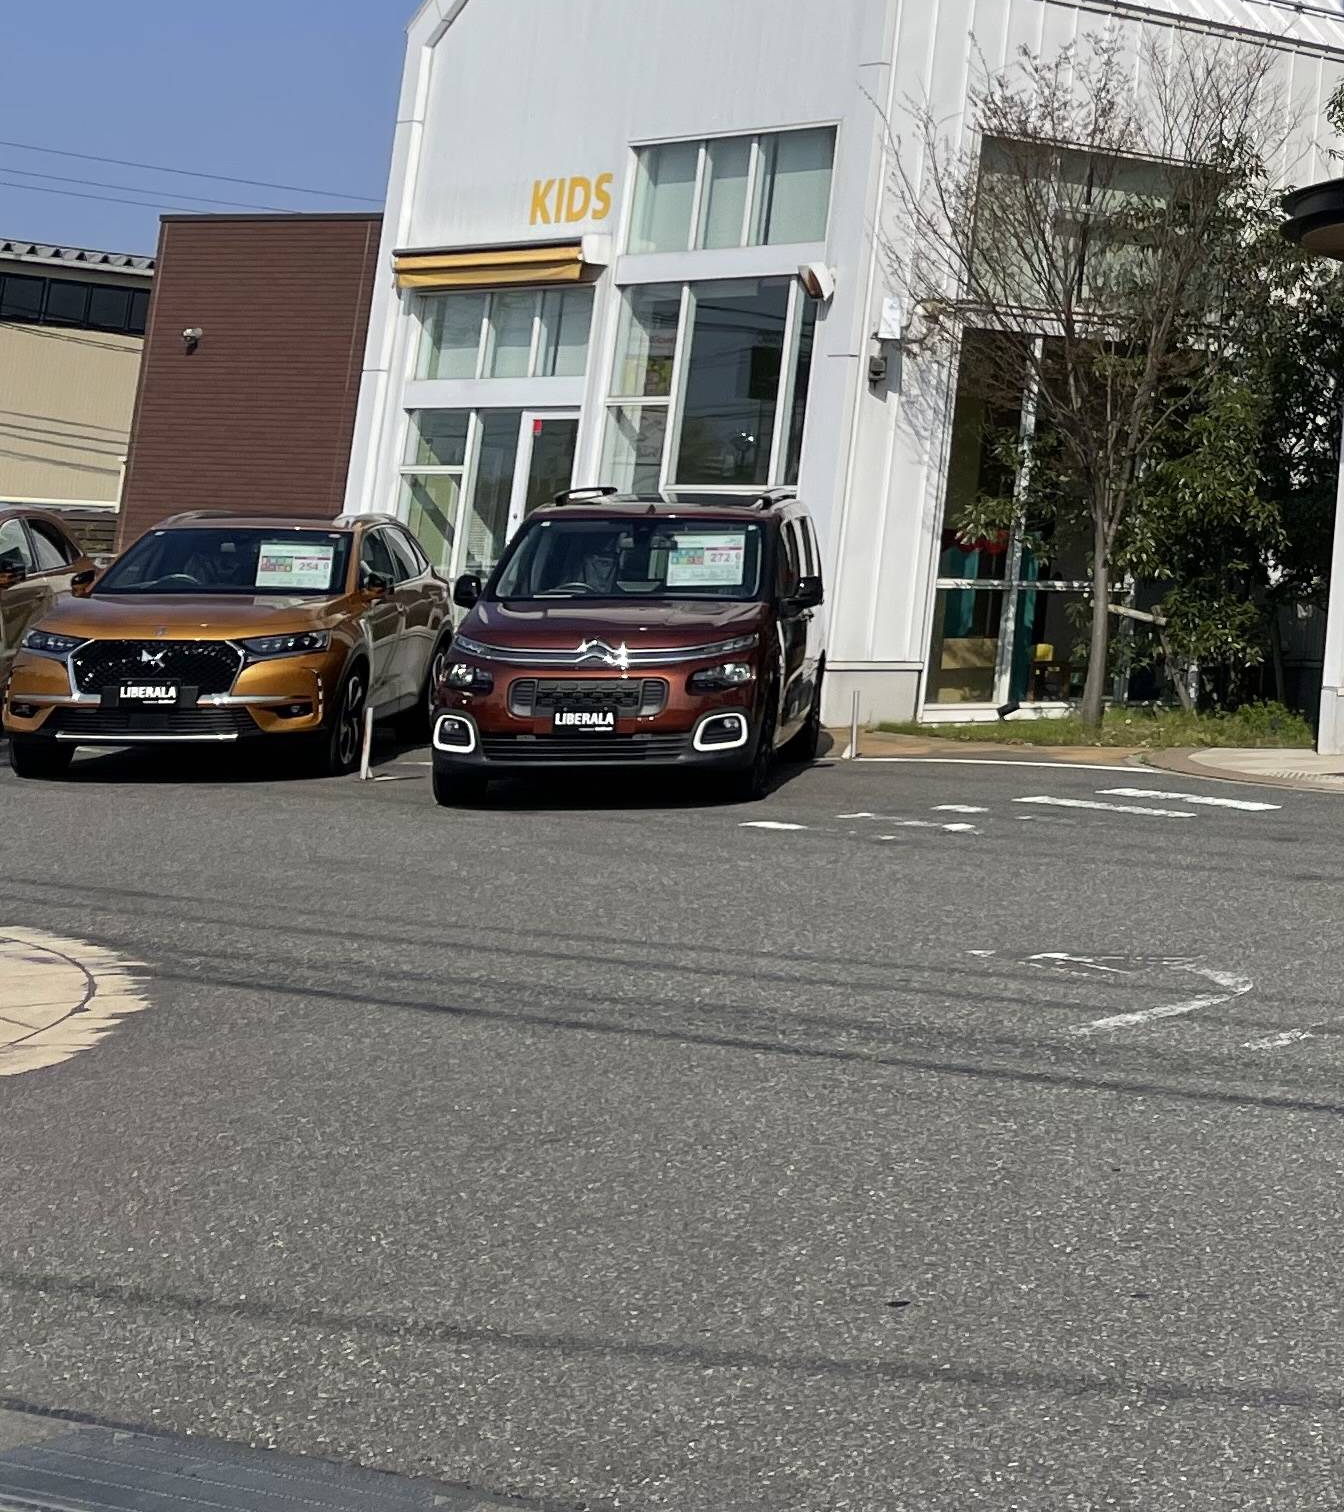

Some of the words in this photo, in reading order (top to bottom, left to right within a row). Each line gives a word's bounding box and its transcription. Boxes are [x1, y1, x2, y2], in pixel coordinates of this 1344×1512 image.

[529, 172, 614, 226] KIDS
[120, 686, 176, 698] LIBERALA
[555, 712, 614, 725] LIBERALA
